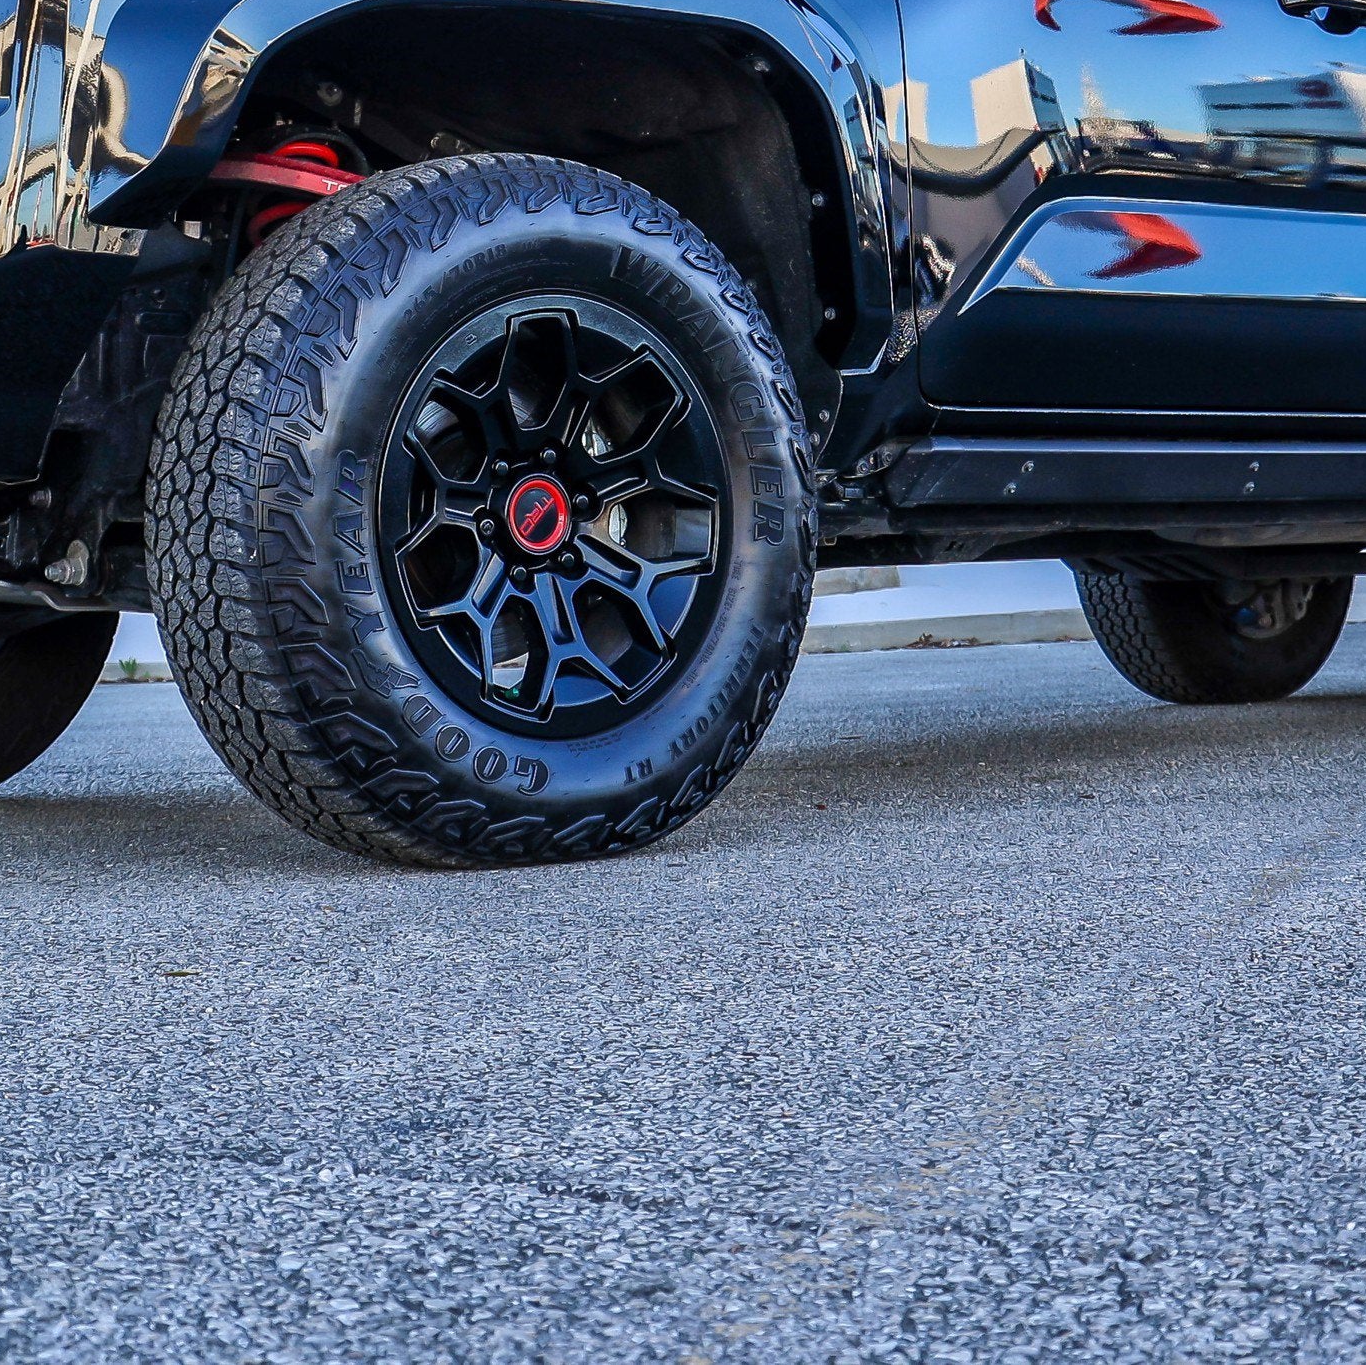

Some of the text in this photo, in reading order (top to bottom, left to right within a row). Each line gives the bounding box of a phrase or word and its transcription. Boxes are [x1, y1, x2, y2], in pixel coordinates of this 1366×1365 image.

[610, 243, 784, 547] WRANGLER
[624, 622, 766, 785] TERRITORY RT
